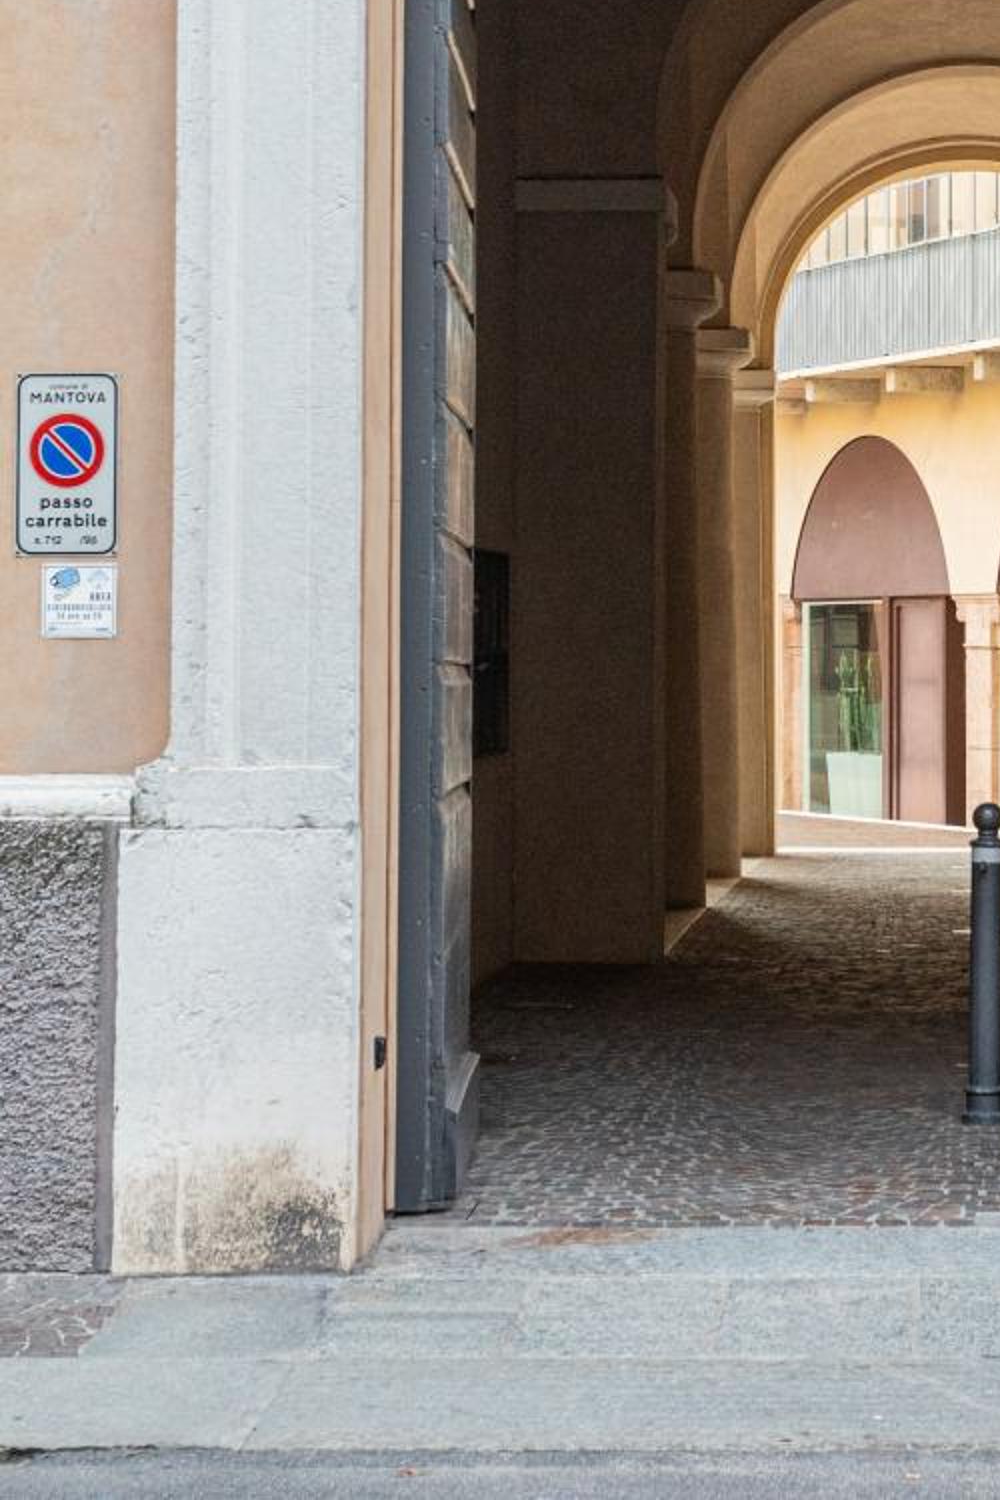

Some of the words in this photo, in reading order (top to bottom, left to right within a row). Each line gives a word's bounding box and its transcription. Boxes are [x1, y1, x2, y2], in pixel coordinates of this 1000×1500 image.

[30, 391, 106, 403] MANTOVA
[40, 497, 93, 510] passo
[25, 513, 107, 527] carrabile
